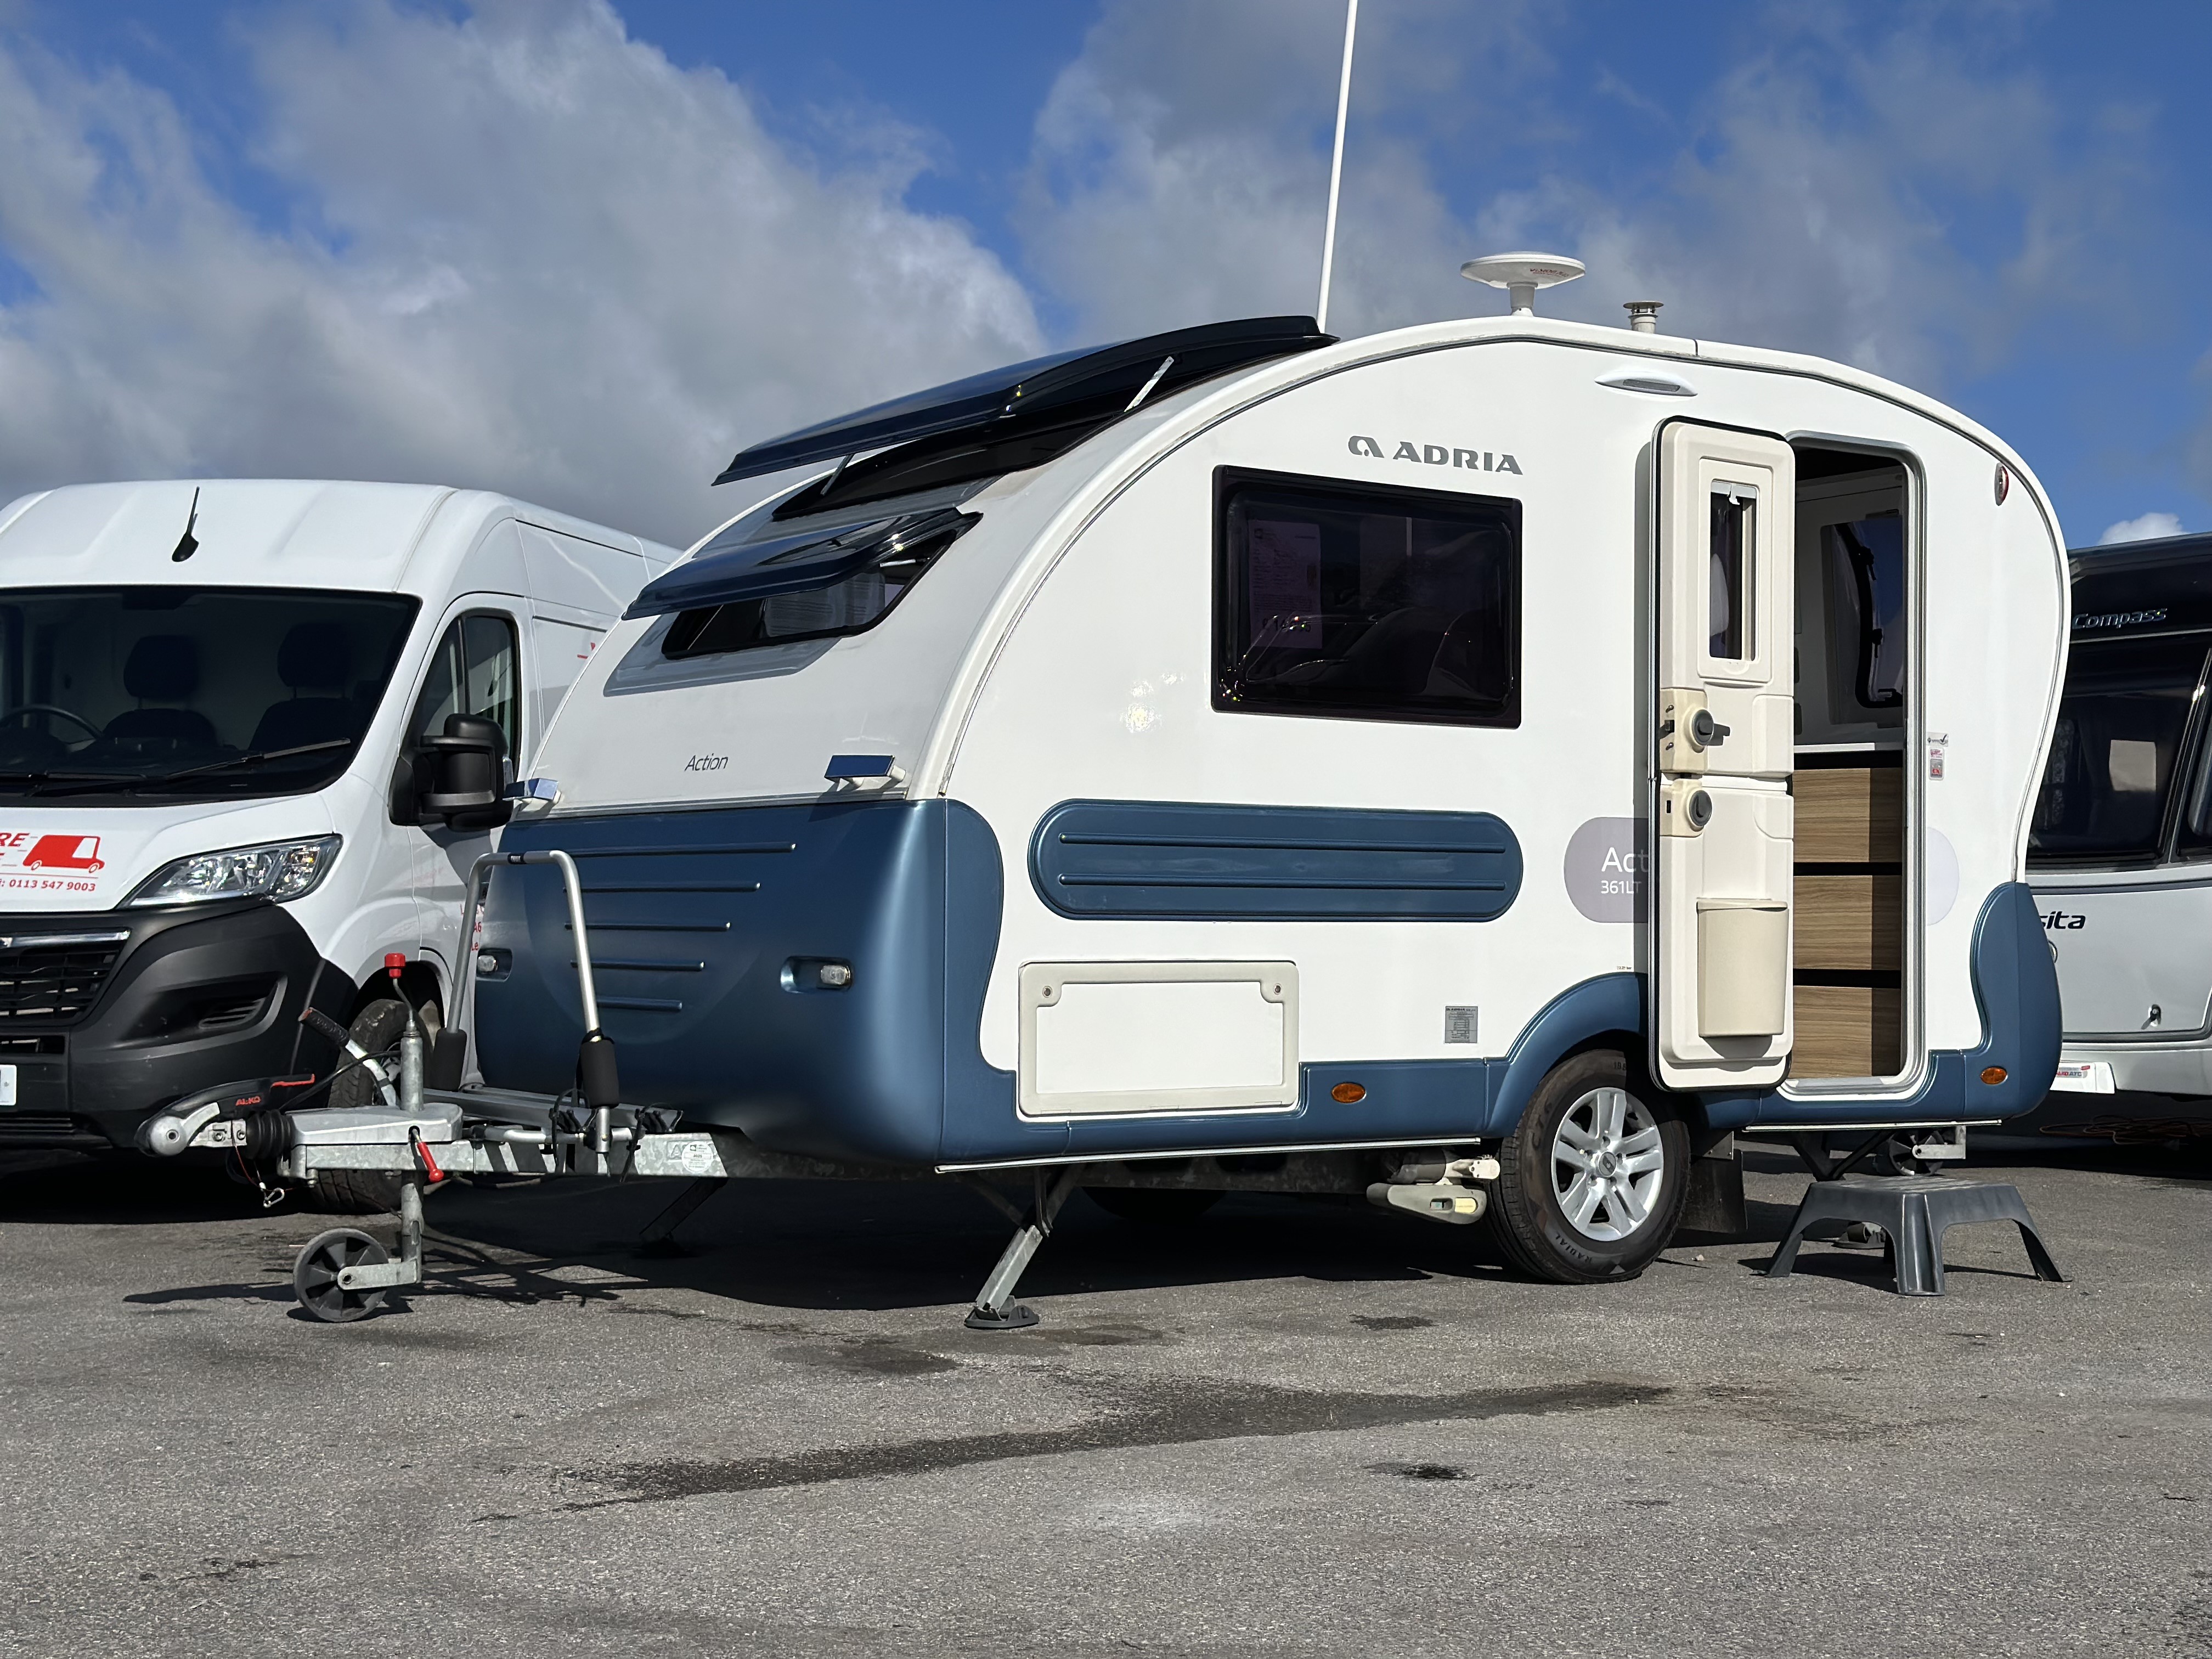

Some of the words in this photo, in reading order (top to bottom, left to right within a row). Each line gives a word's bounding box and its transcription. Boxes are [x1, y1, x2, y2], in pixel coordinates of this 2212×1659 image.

[1392, 441, 1523, 476] ADRIA
[2072, 608, 2168, 629] Compass
[684, 753, 729, 771] Action
[1601, 847, 1649, 872] Act
[9, 879, 37, 888] 0113
[41, 880, 64, 890] 547
[66, 882, 96, 892] 9003
[1601, 880, 1642, 894] 361LT
